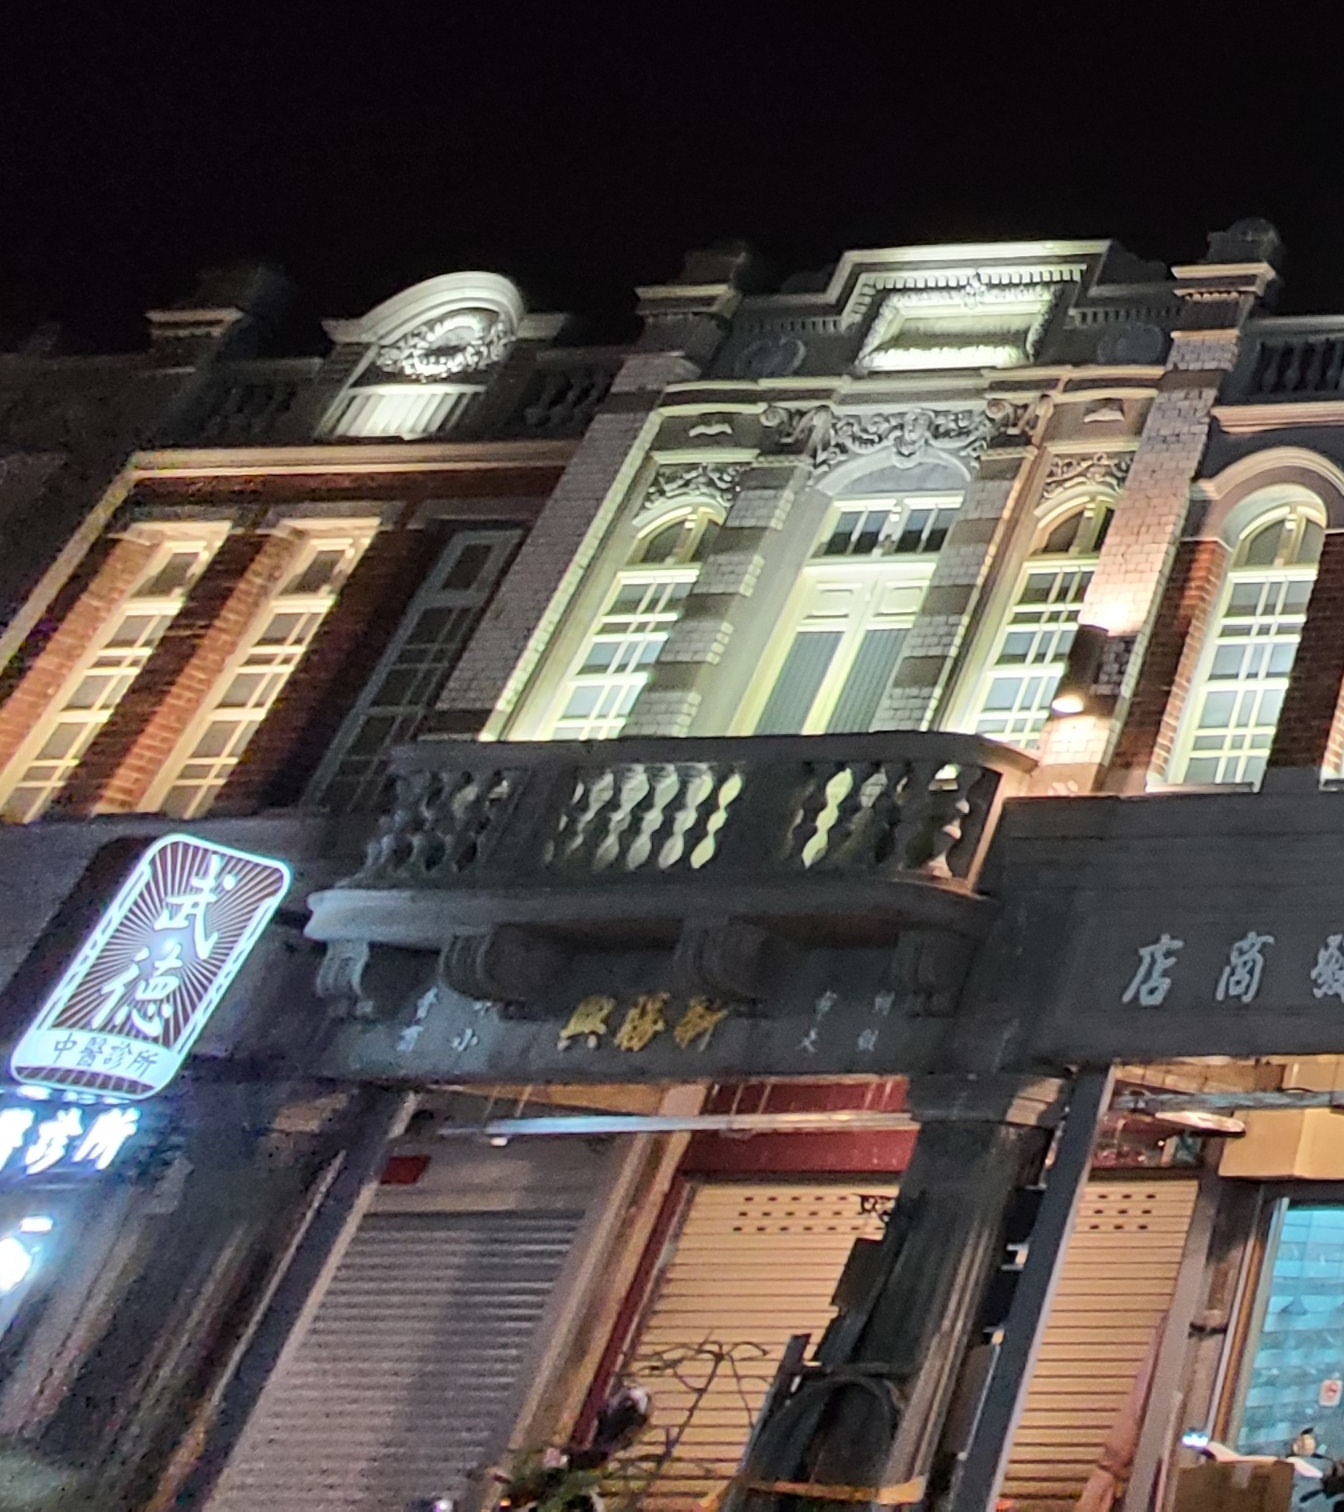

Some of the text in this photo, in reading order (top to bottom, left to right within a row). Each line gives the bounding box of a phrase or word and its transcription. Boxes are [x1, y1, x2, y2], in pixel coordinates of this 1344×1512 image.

[92, 852, 237, 1038] 武德
[53, 1031, 158, 1078] 中醫診所
